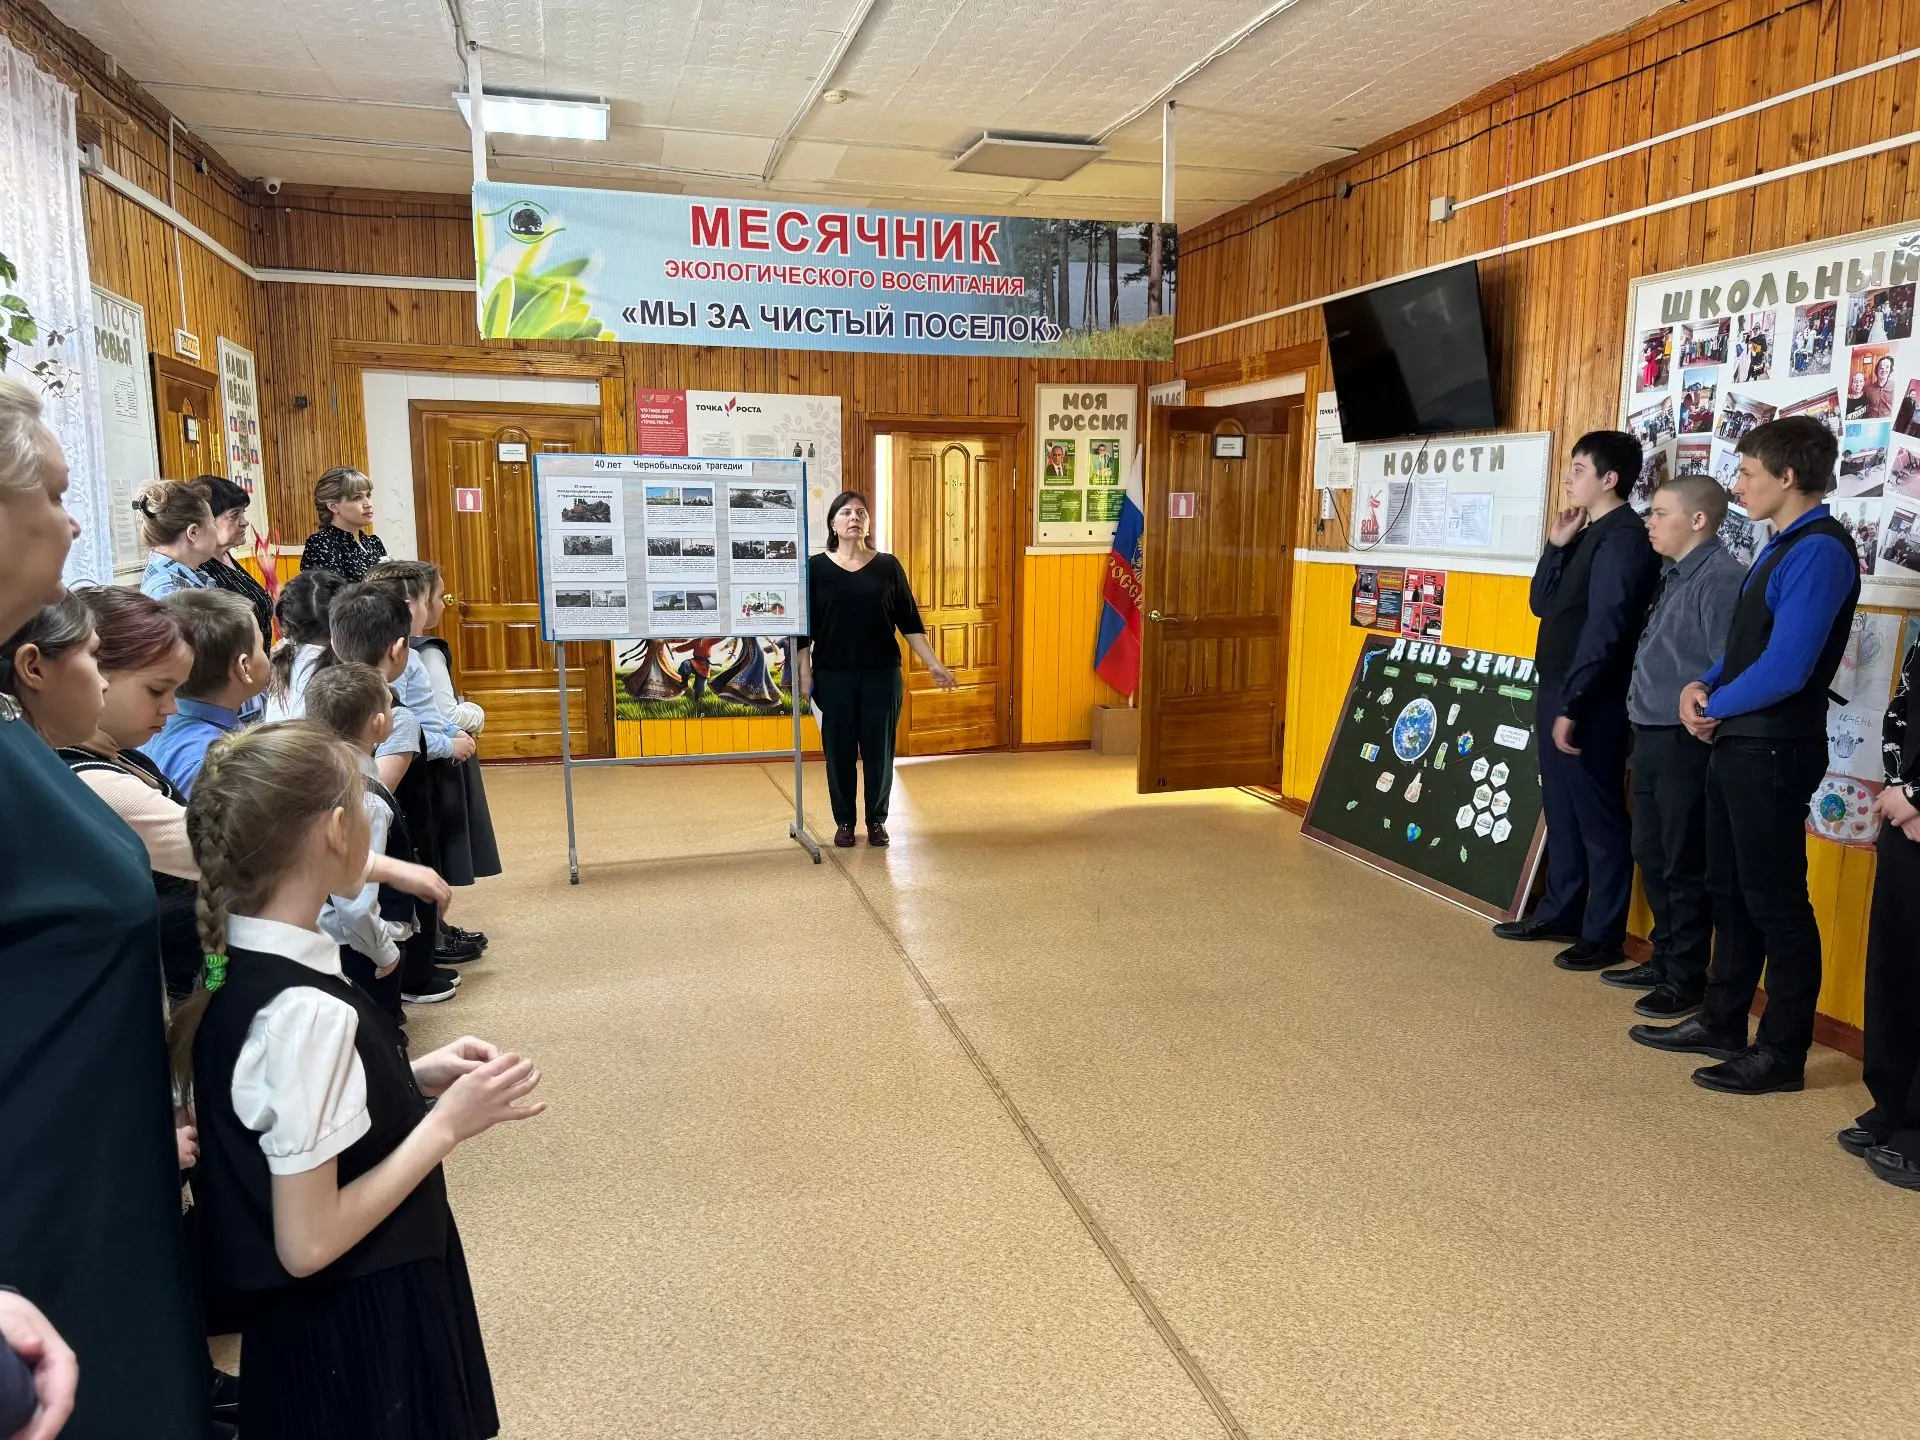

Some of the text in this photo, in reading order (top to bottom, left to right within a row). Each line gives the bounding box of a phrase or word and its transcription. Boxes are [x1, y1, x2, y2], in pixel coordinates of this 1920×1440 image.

[690, 205, 1000, 264] МЕСЯЧНИК
[664, 260, 1025, 296] ЭКОЛОГИЧЕСКОГО ВОСПИТАНИЯ
[1661, 235, 1920, 324] ШКОЛЬНЫЙ
[100, 296, 137, 340] ПОСТ
[622, 300, 1062, 343] «МЫ ЗА ЧИСТЫЙ ПОСЕЛОК»
[696, 404, 723, 412] ТОЧКА
[1063, 392, 1108, 410] МОЯ
[1048, 413, 1129, 431] РОССИЯ
[594, 460, 605, 468] 40
[633, 460, 702, 471] Чернобыльской
[706, 461, 743, 471] трагедии
[1383, 444, 1505, 477] НОВОСТИ
[1387, 638, 1452, 666] ДЕНЬ
